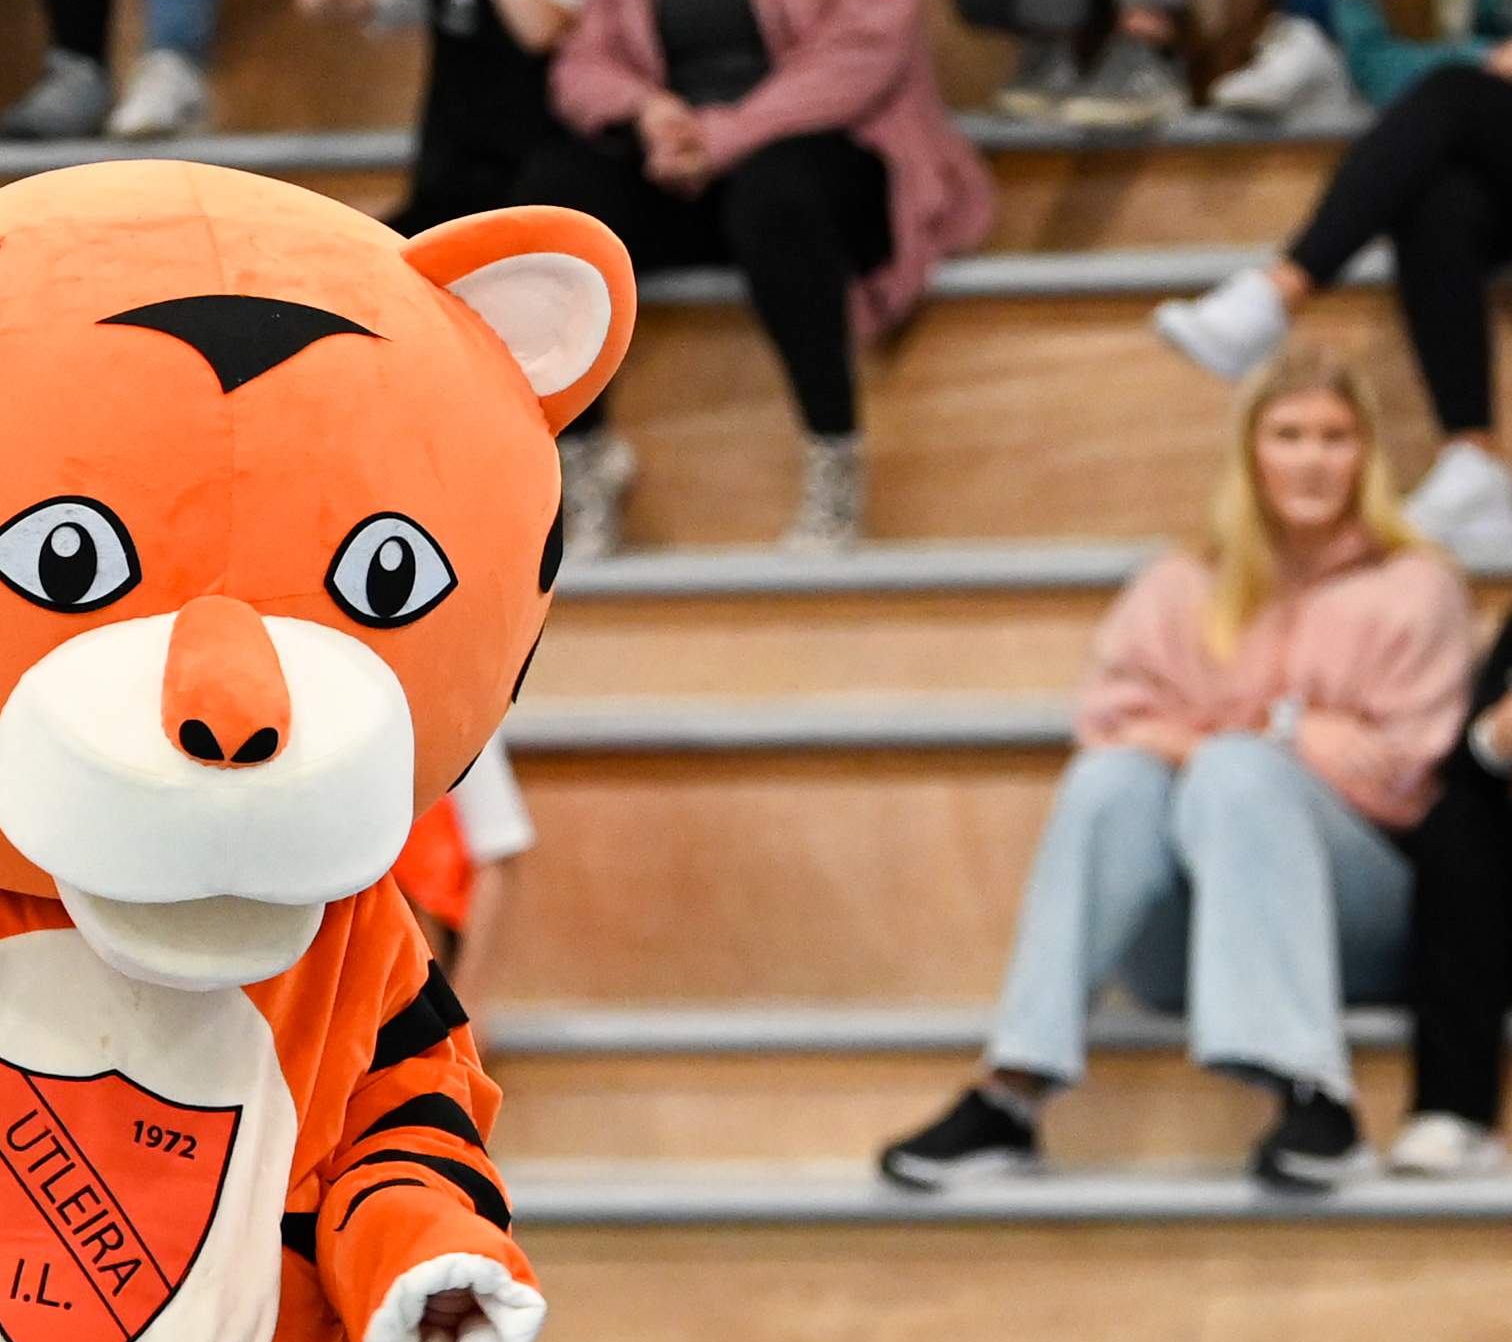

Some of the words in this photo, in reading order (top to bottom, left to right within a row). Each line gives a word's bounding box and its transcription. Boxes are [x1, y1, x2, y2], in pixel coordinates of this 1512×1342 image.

[133, 1119, 198, 1160] 1972
[5, 1109, 143, 1297] UTLEIRA
[10, 1258, 73, 1311] I.L.
